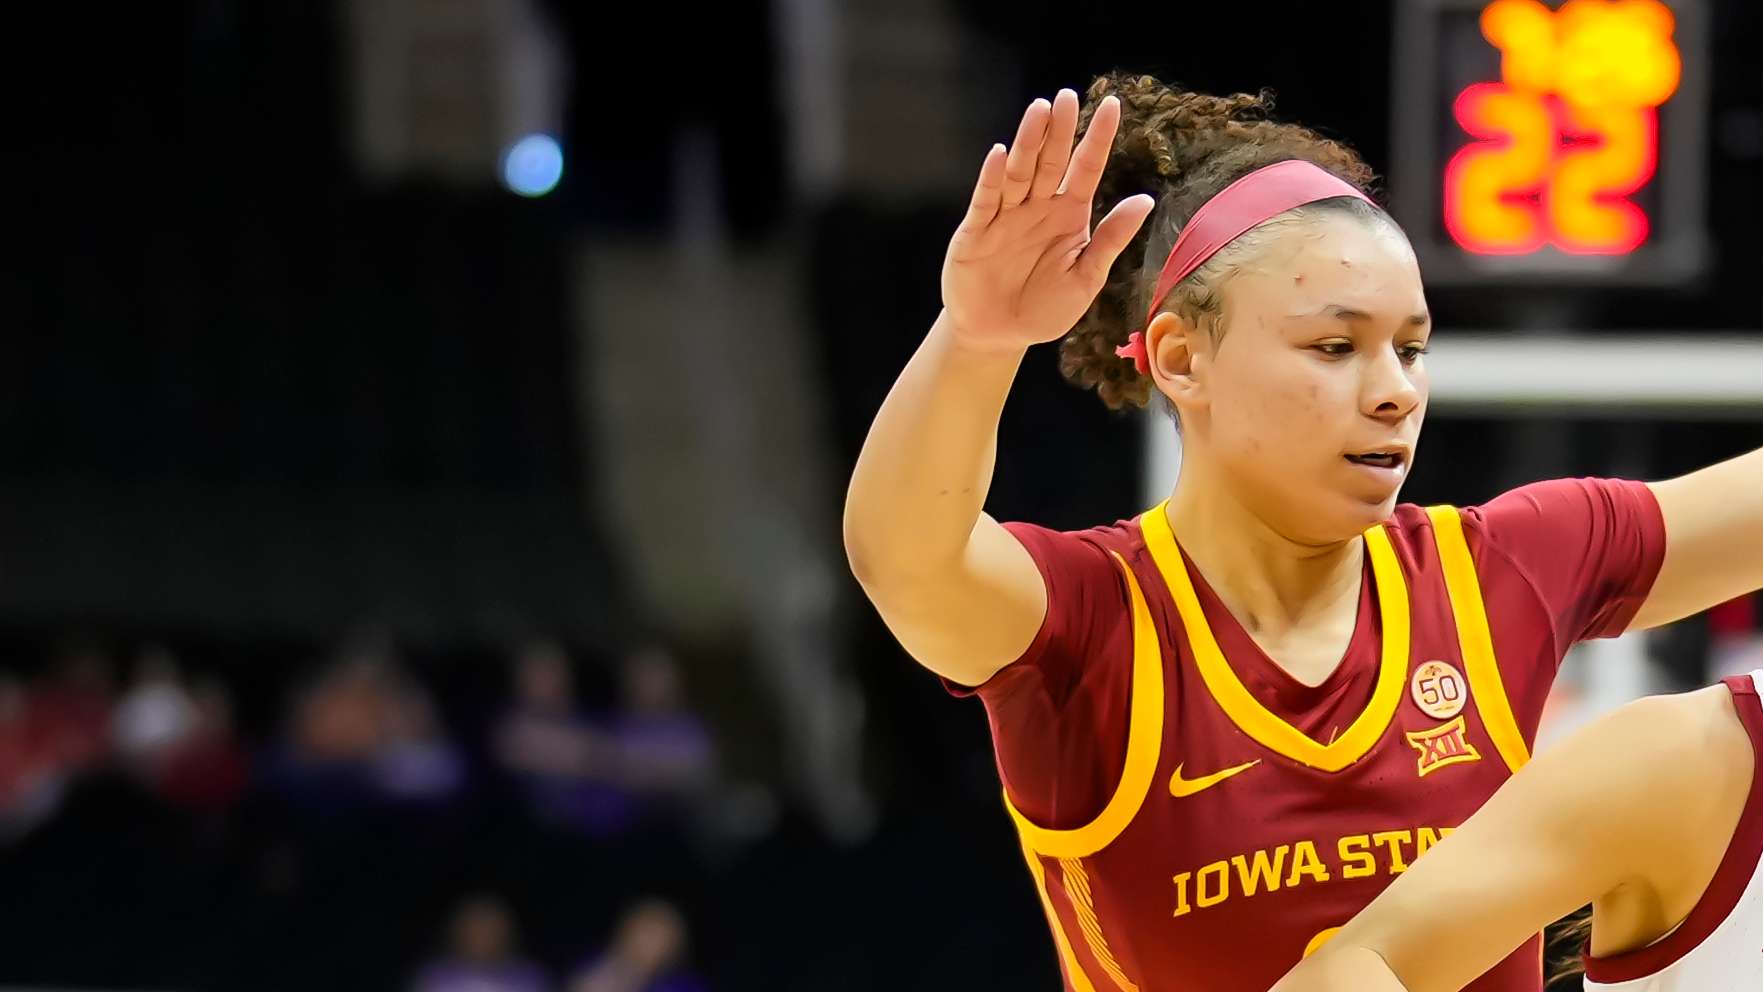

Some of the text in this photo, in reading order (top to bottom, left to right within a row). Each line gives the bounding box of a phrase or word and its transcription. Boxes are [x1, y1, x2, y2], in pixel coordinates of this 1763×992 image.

[1419, 675, 1459, 705] 50
[1173, 827, 1456, 917] IOWA STA
